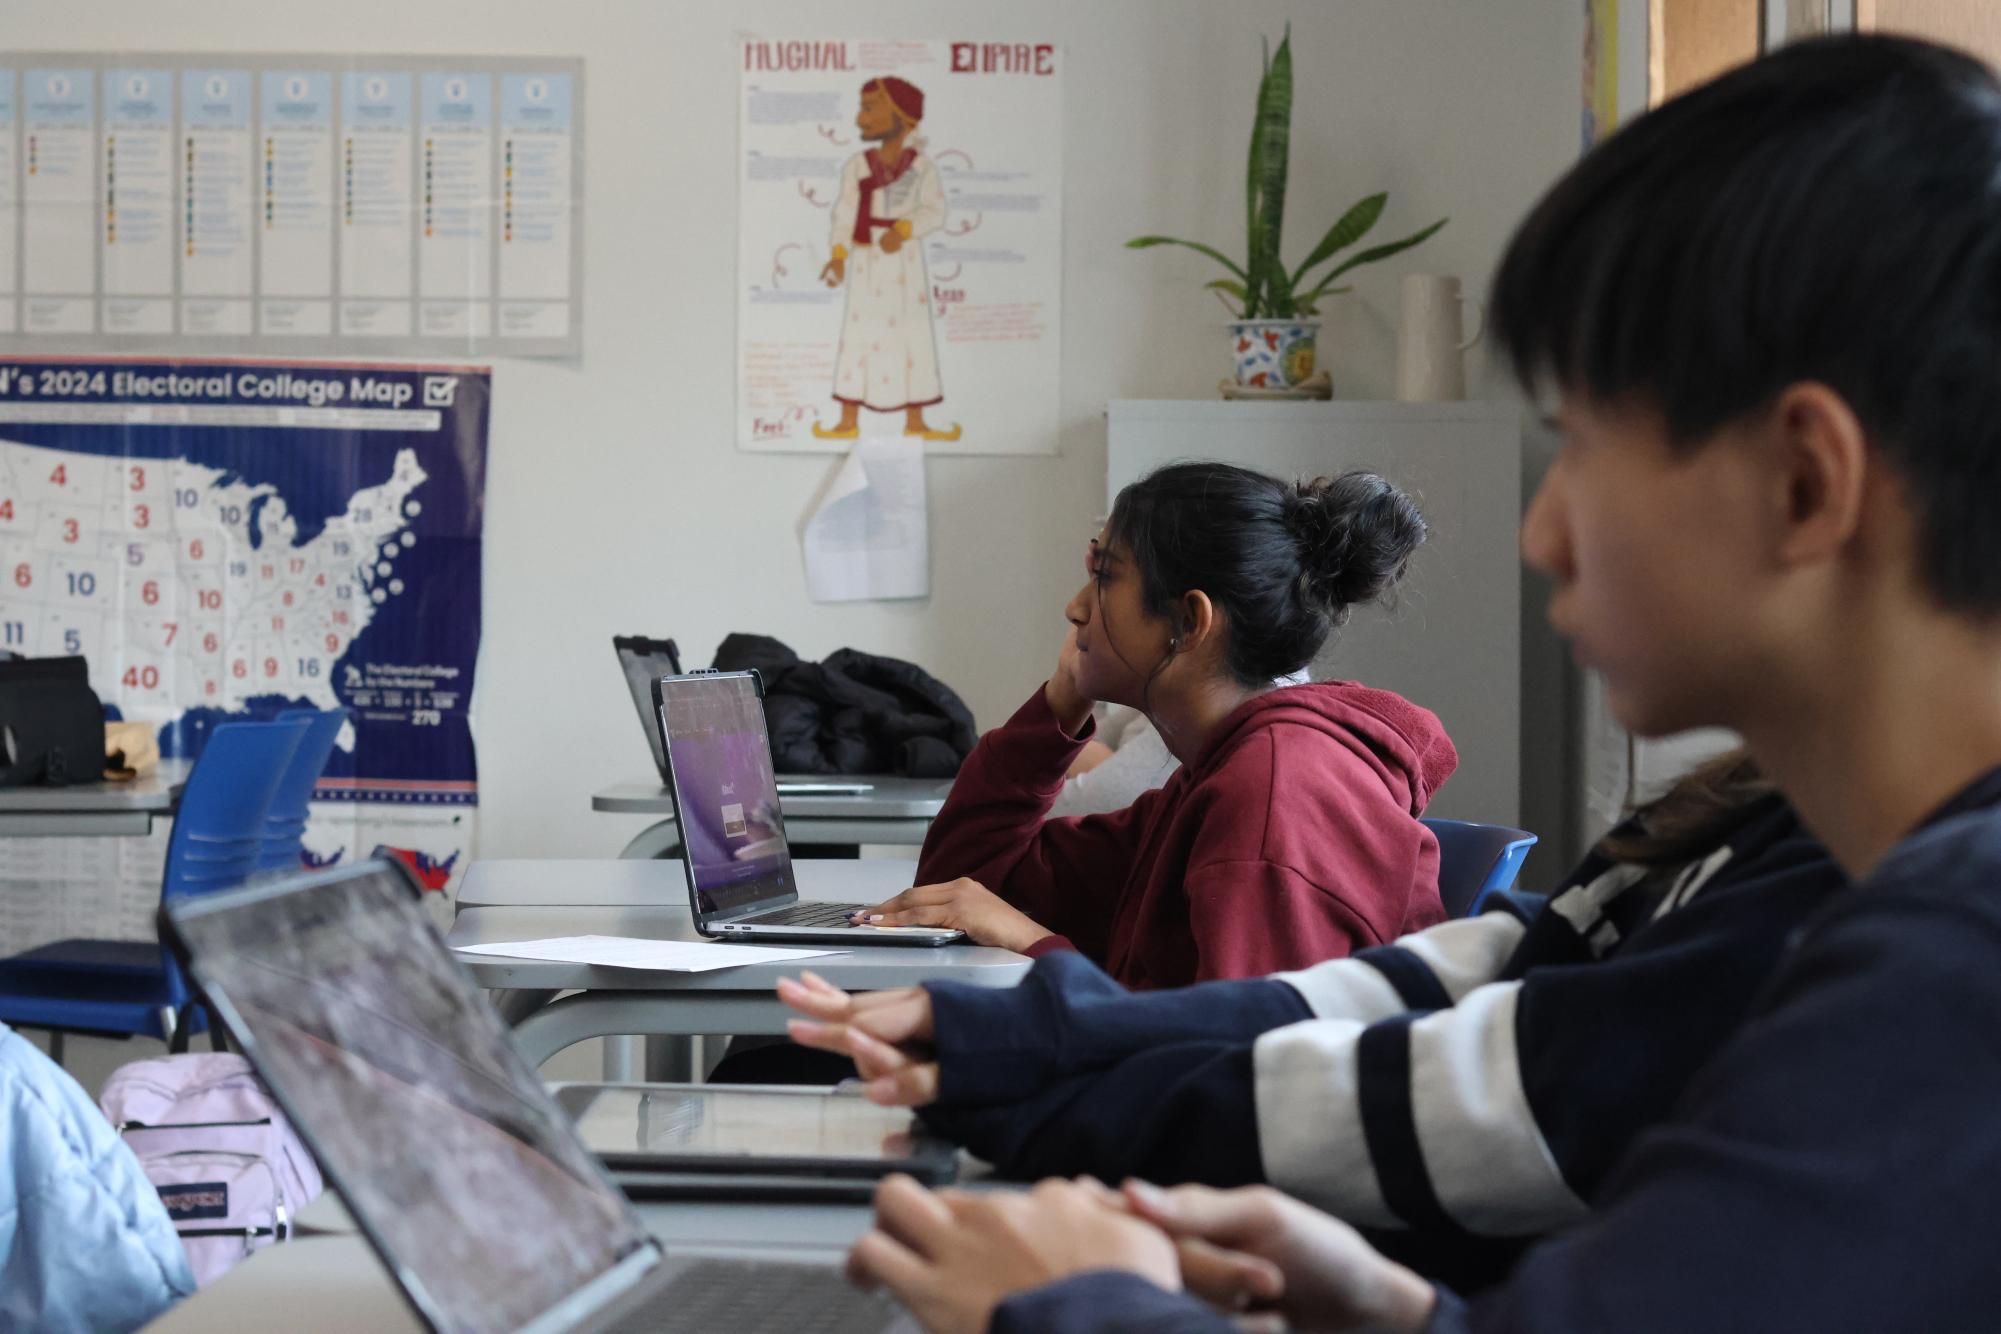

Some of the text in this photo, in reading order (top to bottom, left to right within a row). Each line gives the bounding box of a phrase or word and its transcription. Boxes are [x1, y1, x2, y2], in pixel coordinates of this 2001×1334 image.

[40, 370, 107, 396] 2024
[112, 371, 233, 397] Electoral
[237, 374, 345, 405] College
[350, 377, 413, 409] Map
[49, 462, 67, 487] 4
[129, 465, 146, 492] 3
[175, 488, 199, 508] 10
[132, 504, 150, 529] 3
[220, 505, 241, 525] 10
[63, 518, 79, 544] 3
[126, 543, 145, 566] 5
[189, 538, 204, 561] 6
[15, 562, 33, 588] 6
[66, 571, 96, 597] 10
[142, 580, 160, 606] 6
[197, 589, 222, 610] 10
[5, 621, 24, 645] 11
[64, 628, 81, 656] 5
[162, 623, 178, 648] 7
[203, 632, 218, 653] 6
[121, 665, 159, 690] 40
[298, 658, 320, 678] 16
